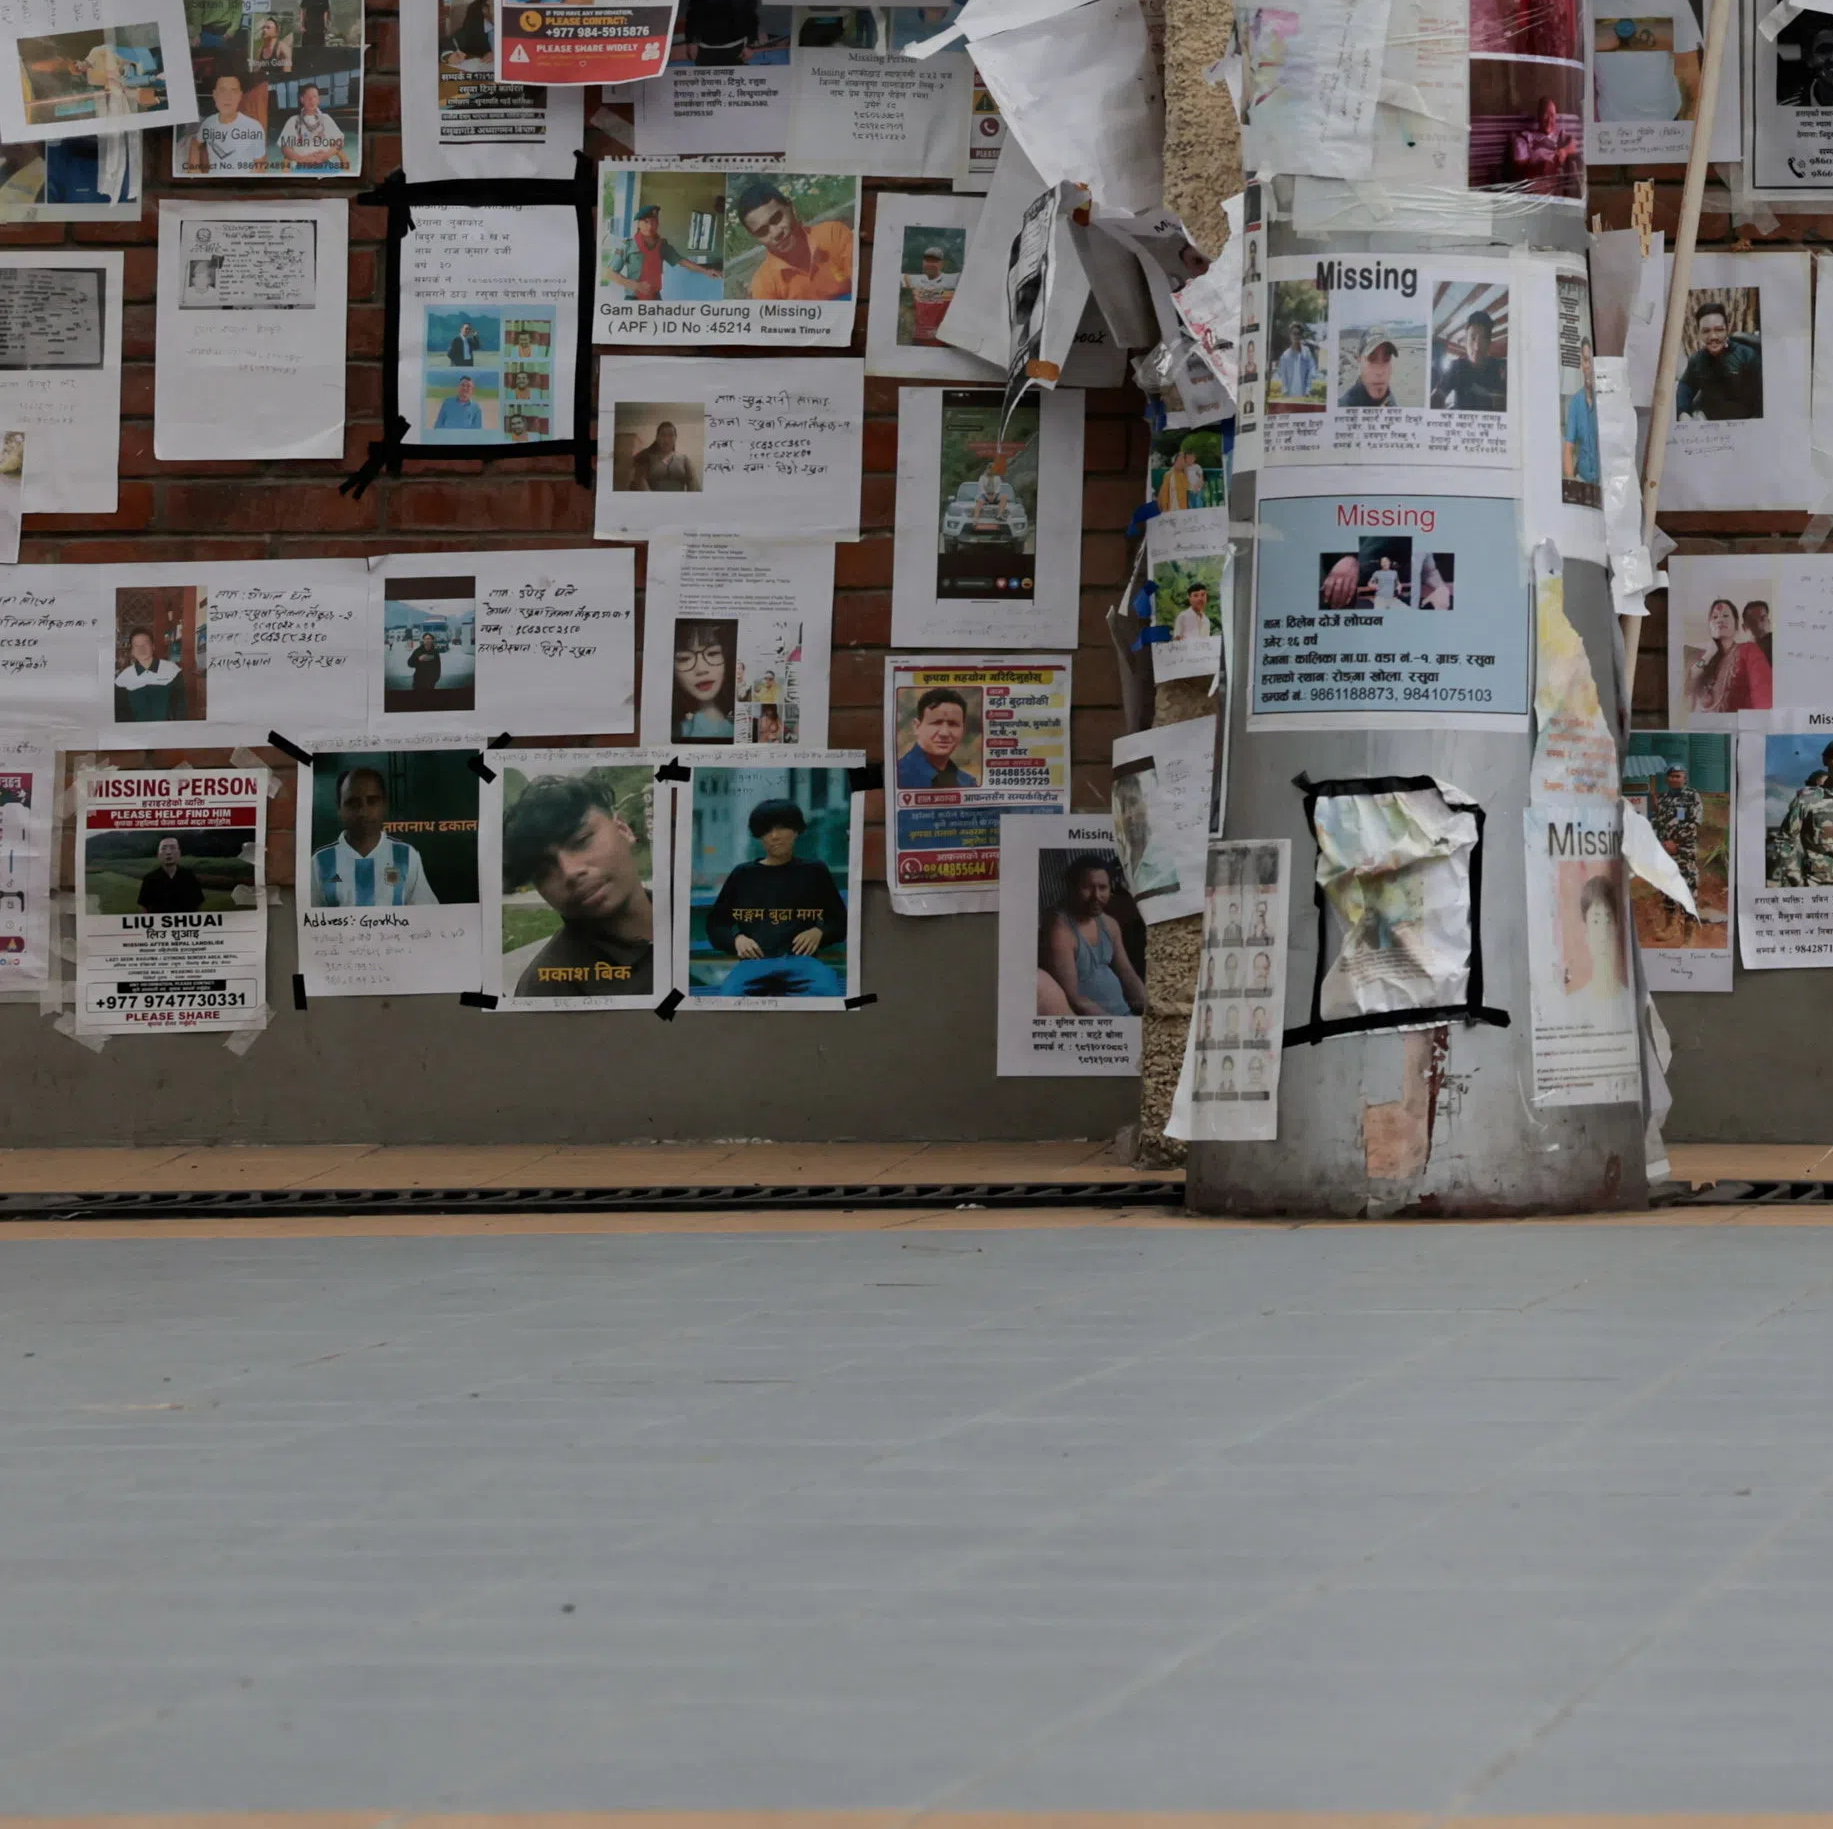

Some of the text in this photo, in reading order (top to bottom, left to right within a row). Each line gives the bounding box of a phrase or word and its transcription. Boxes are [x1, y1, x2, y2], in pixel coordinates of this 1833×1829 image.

[546, 26, 650, 38] +977 984-5915876
[1316, 261, 1417, 298] Missing
[600, 303, 822, 321] Gam Bahadur Gurung (Missing)
[1337, 504, 1435, 533] Missing
[1310, 687, 1492, 702] 9861188873, 9841075103
[87, 778, 257, 798] MISSING PERSON
[122, 915, 223, 929] LIU SHUAI
[96, 992, 246, 1009] +977 9747730331
